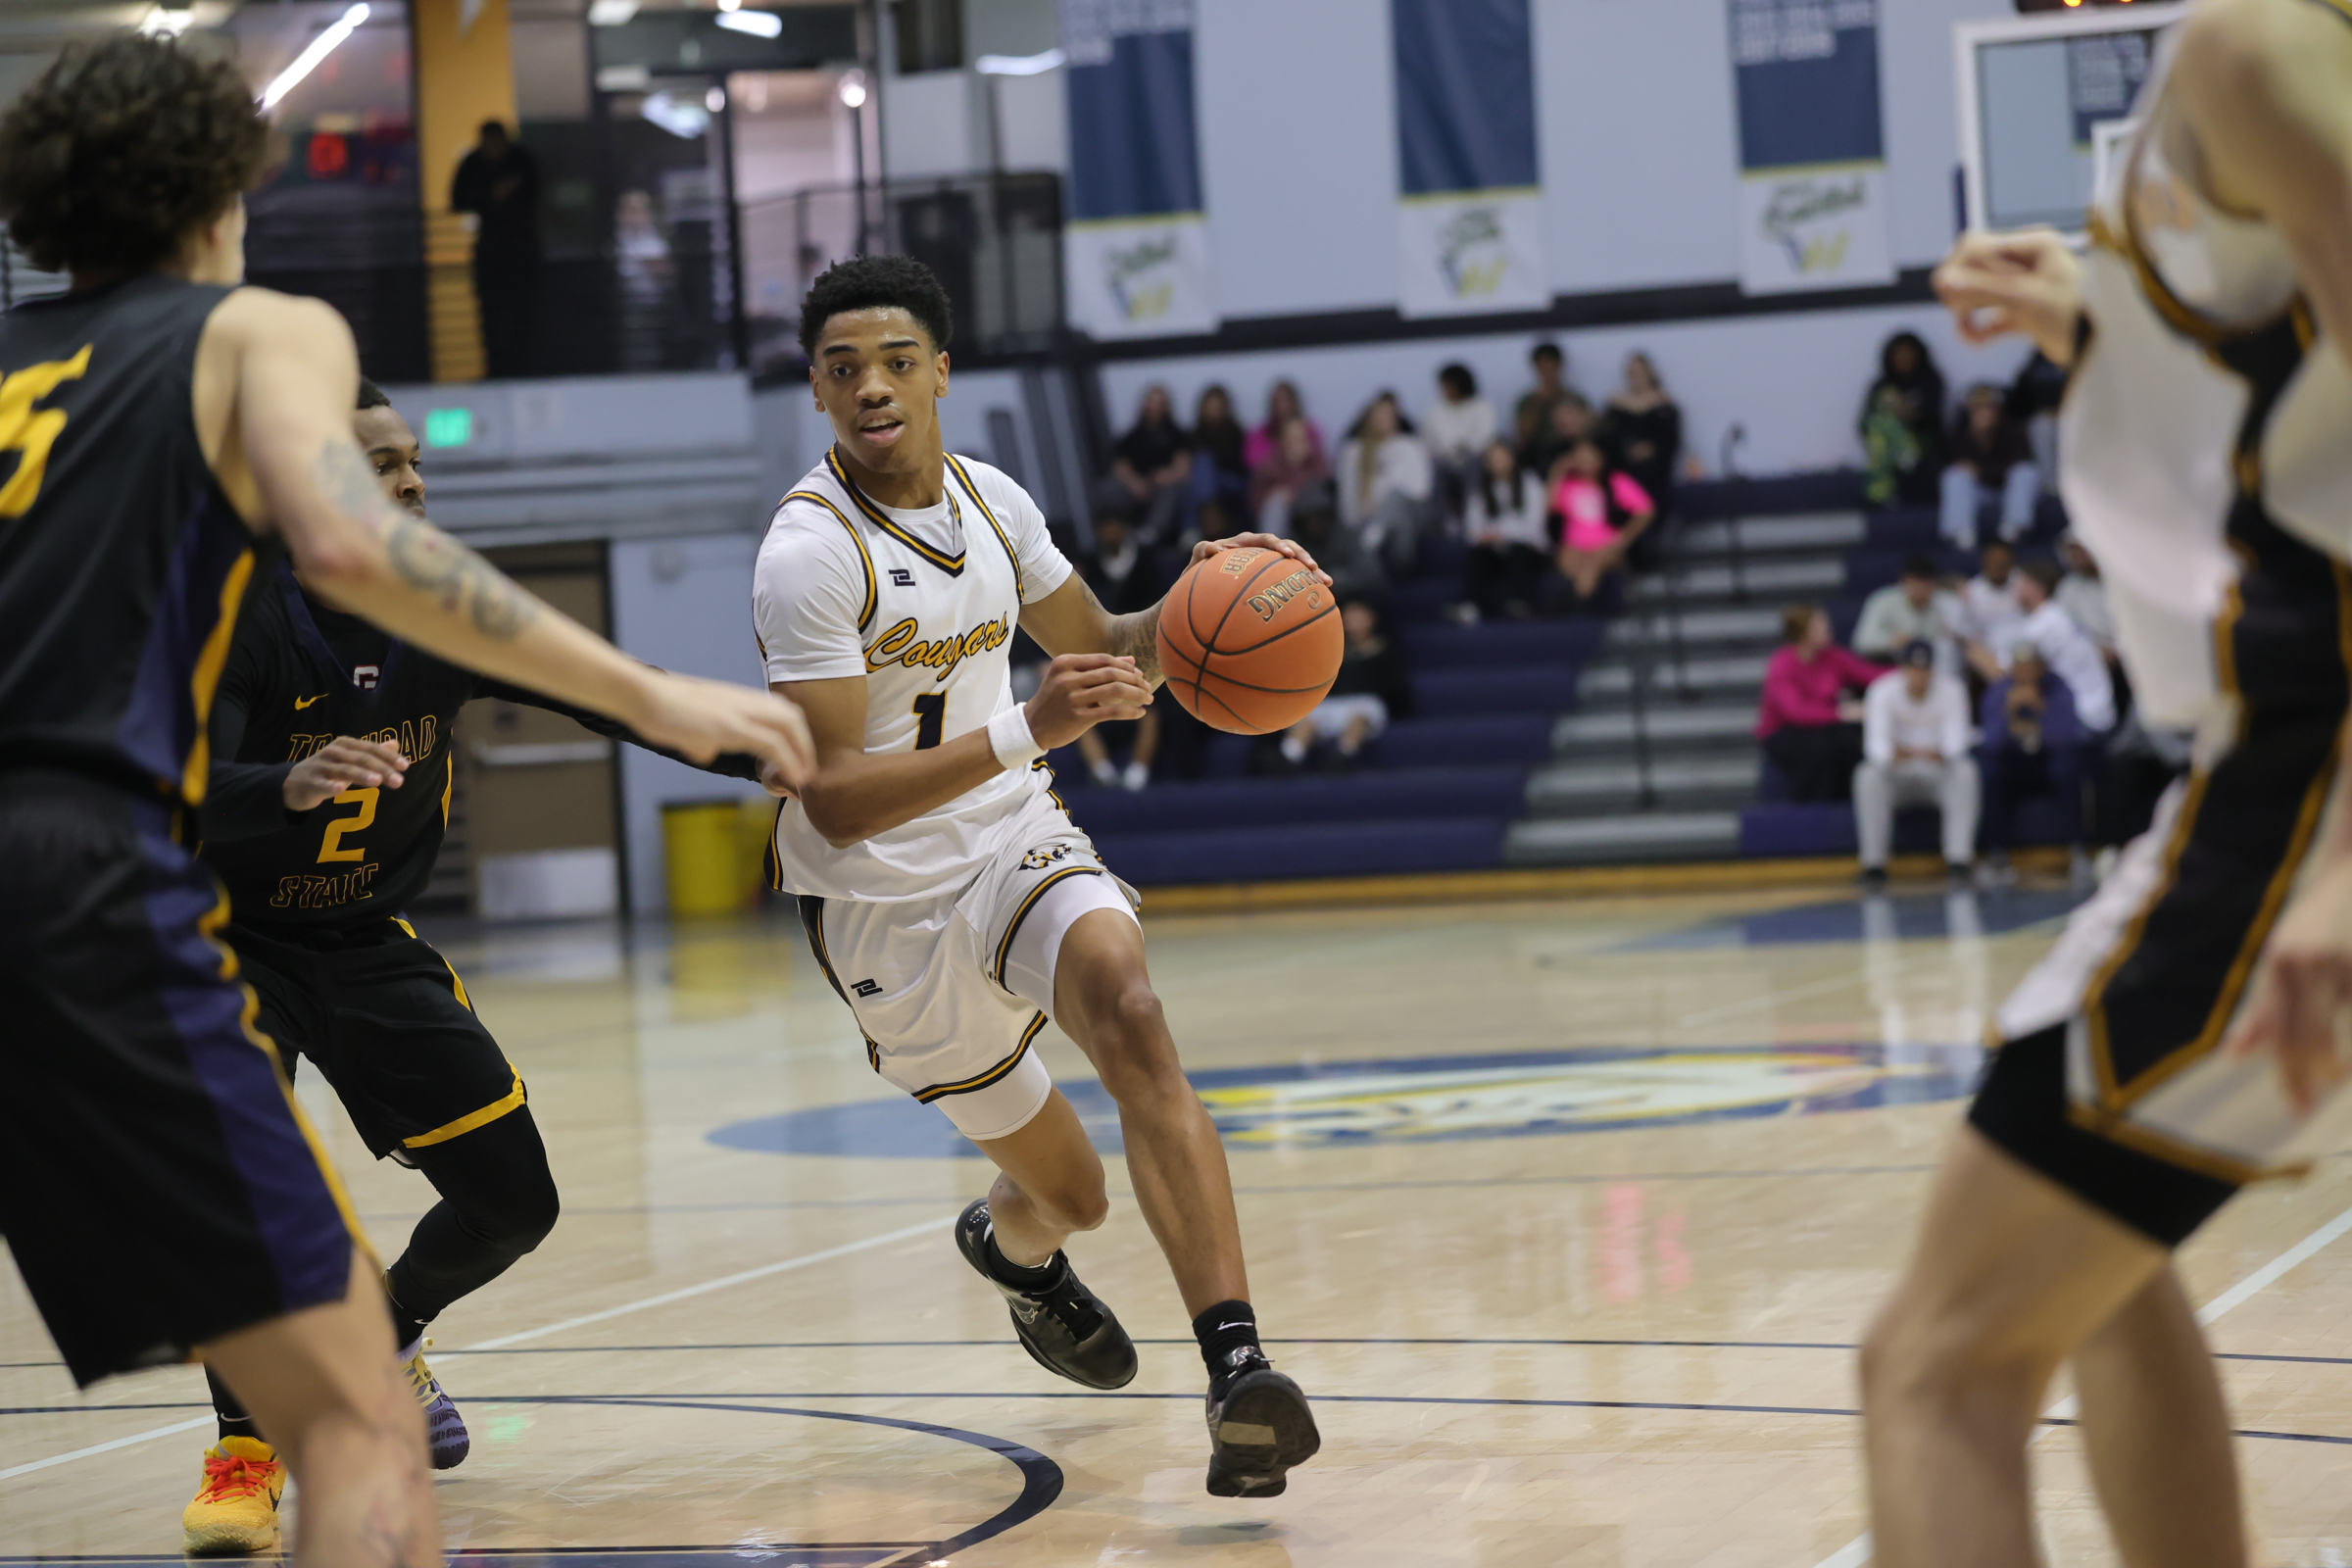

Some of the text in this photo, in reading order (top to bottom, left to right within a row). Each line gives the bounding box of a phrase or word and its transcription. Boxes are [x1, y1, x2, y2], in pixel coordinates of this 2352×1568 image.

[863, 611, 1009, 682] Cougars
[911, 688, 949, 752] 1
[316, 786, 380, 864] 2
